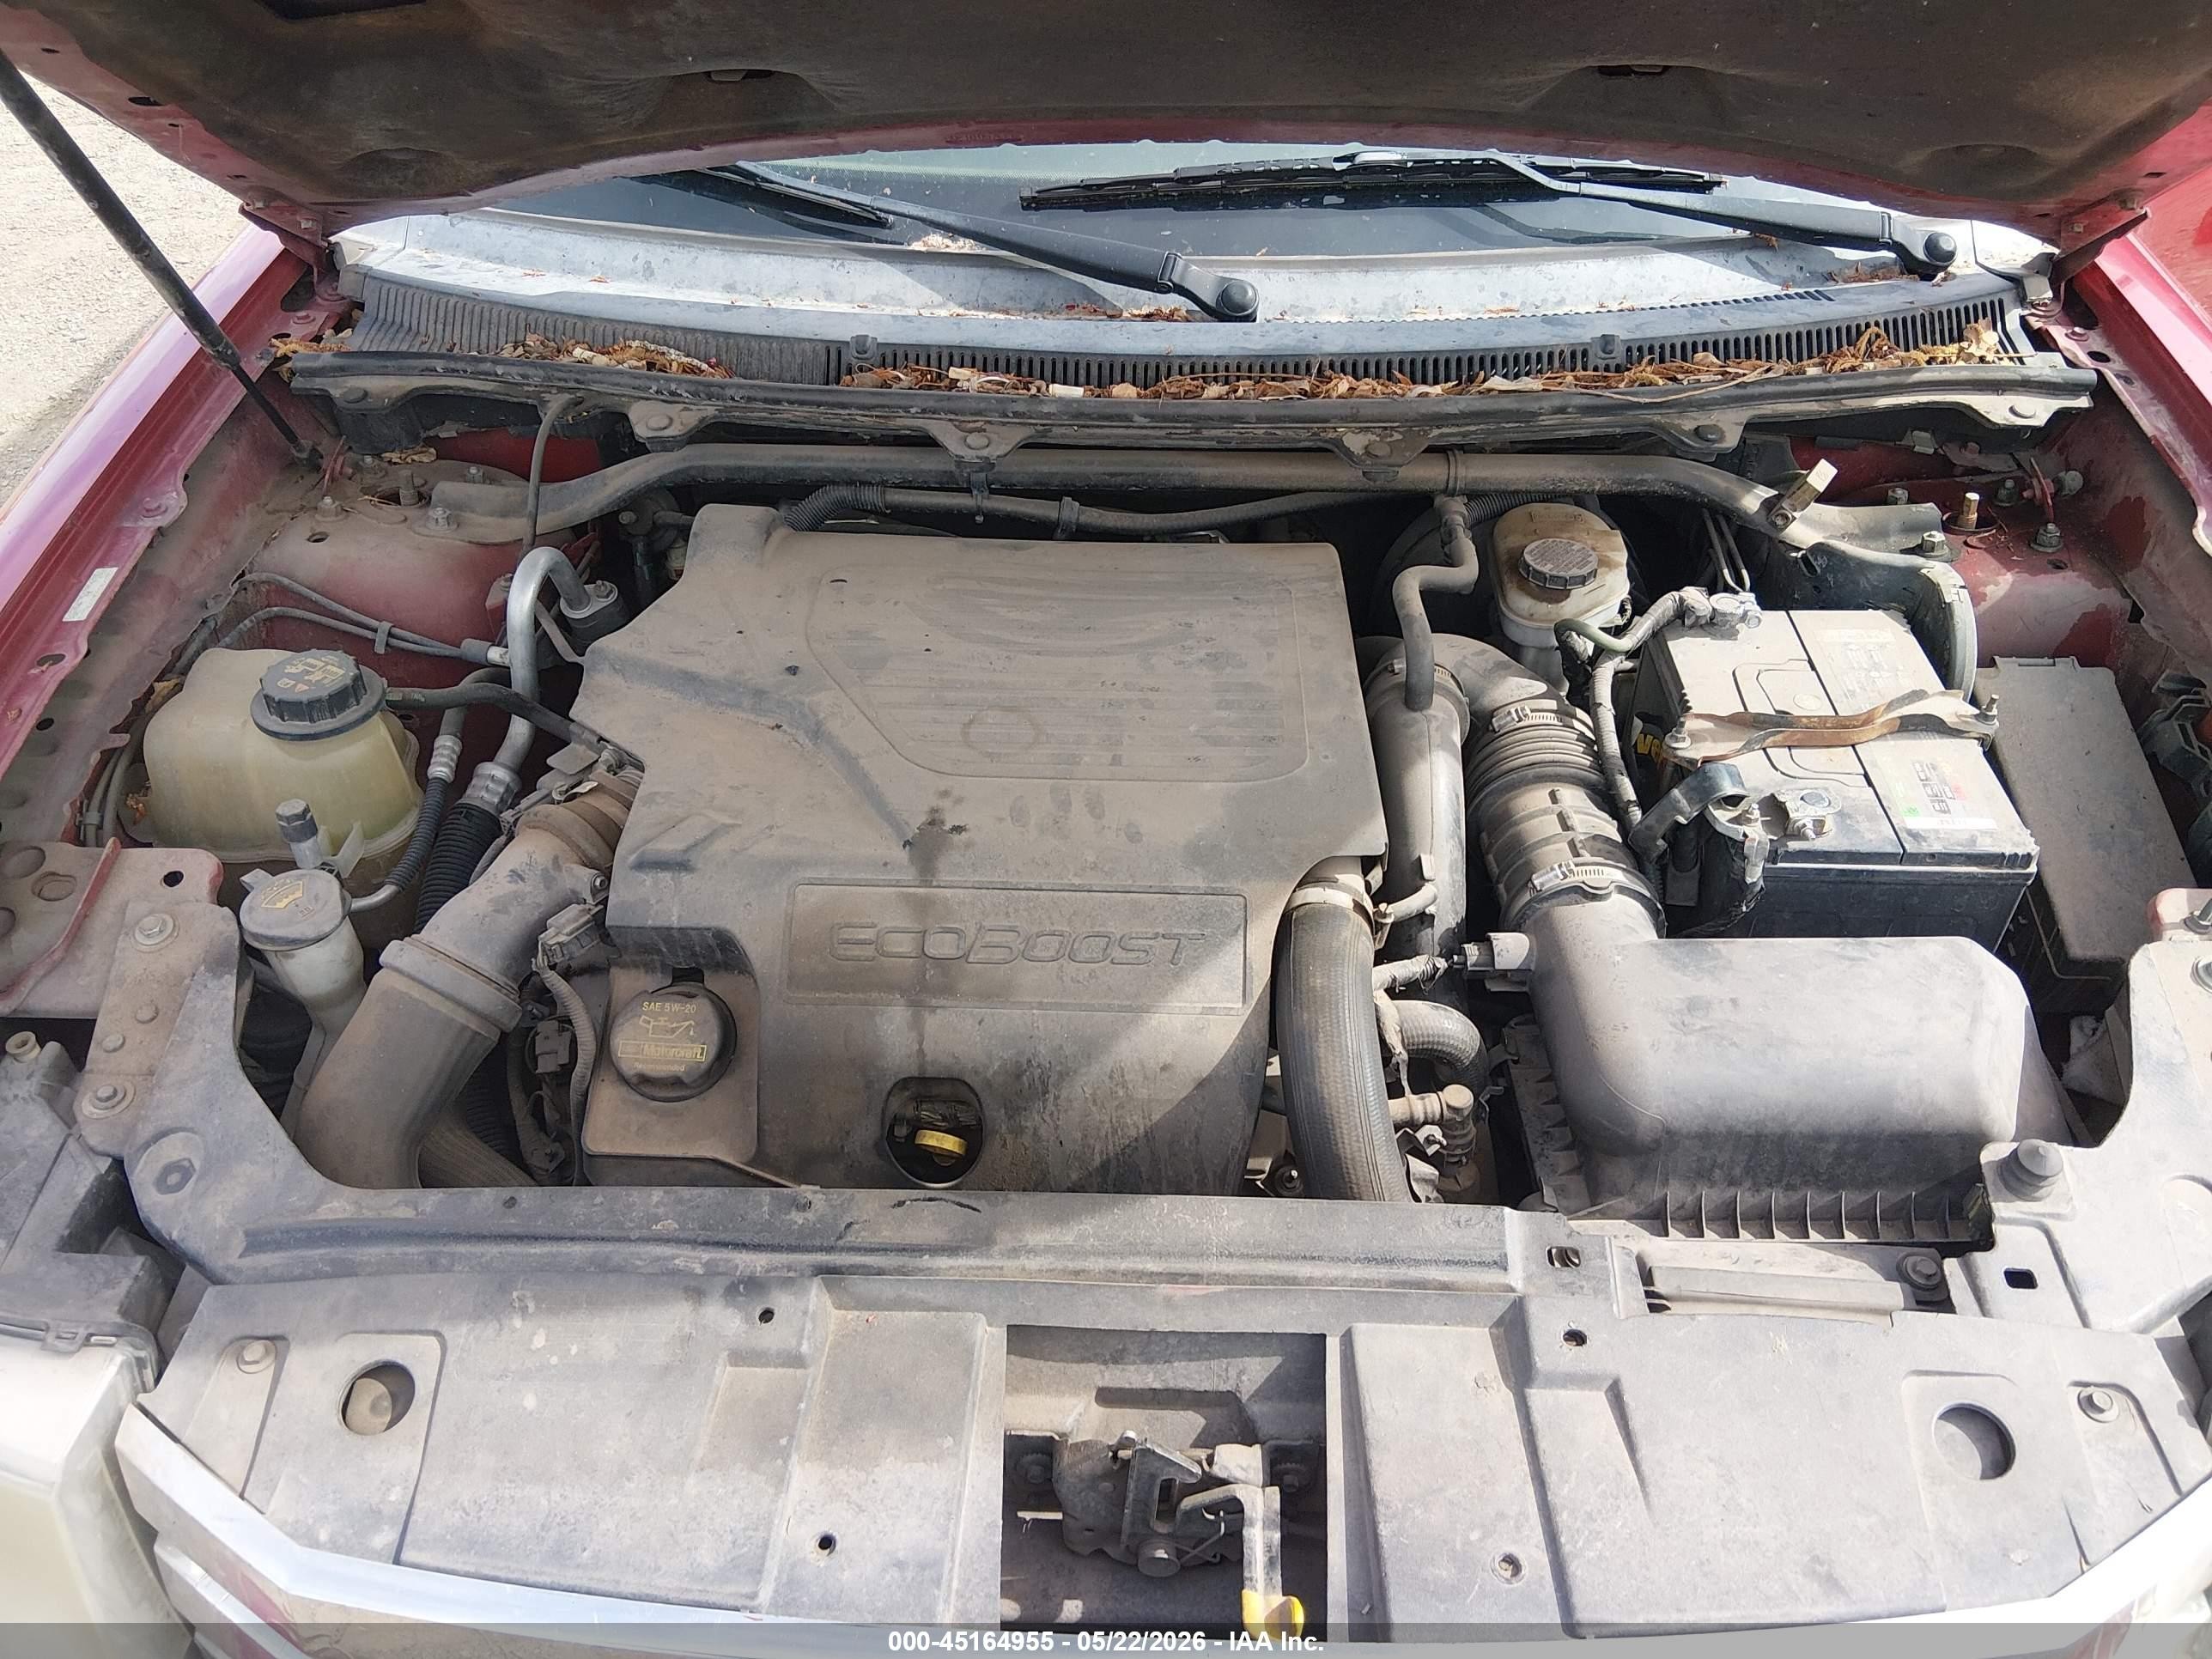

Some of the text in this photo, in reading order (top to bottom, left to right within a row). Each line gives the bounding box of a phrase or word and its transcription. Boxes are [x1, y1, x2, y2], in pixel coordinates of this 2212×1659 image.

[642, 1001, 696, 1012] SAE 5W-20
[645, 1044, 703, 1059] Motorcraft
